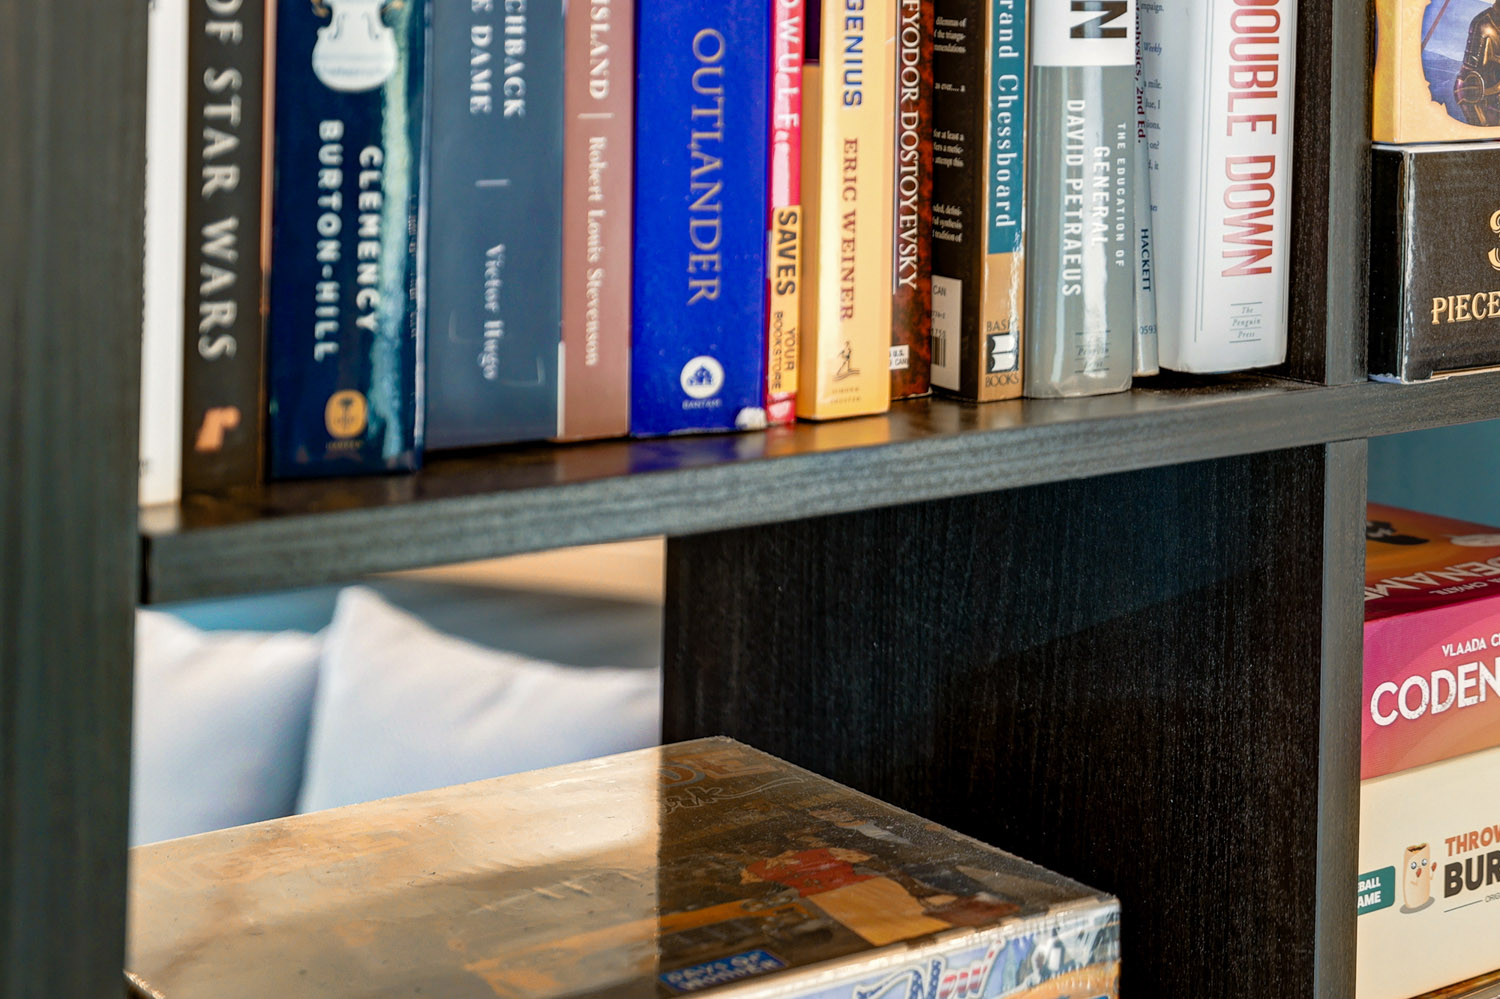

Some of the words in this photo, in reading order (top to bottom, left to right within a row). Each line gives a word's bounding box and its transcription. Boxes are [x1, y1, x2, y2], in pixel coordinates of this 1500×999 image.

[469, 25, 493, 115] DAME
[1136, 87, 1145, 115] 2nd
[202, 67, 244, 199] STAR
[687, 27, 727, 306] OUTLANDER
[995, 73, 1020, 230] Chessboard
[1065, 99, 1086, 168] DAVID
[1117, 122, 1127, 151] THE
[1137, 118, 1146, 144] Ed.
[588, 136, 608, 201] Robert
[842, 137, 859, 202] ERIC
[895, 110, 920, 290] DOSTOYEVSKY
[1091, 146, 1111, 247] GENERAL
[1115, 158, 1126, 243] EDUCATION
[313, 120, 344, 363] BURTON-HILL
[355, 145, 384, 333] CLEMENCY
[588, 209, 607, 263] Louis
[1061, 177, 1085, 296] PETRAEUS
[1220, 154, 1276, 279] DOWN
[197, 216, 239, 360] WARS
[484, 244, 505, 312] Victor
[776, 211, 798, 297] SAVES
[839, 211, 858, 323] WEINER
[1114, 250, 1125, 267] OF
[1141, 229, 1152, 292] HACKETT
[477, 320, 505, 380] Hugo
[585, 267, 606, 366] Stevenson
[770, 311, 784, 391] BOOKSTORE
[783, 327, 797, 372] YOUR
[1232, 317, 1261, 327] Penguin
[1238, 331, 1255, 339] Press
[985, 373, 1020, 388] BOOKS
[1441, 637, 1487, 658] VLAADA
